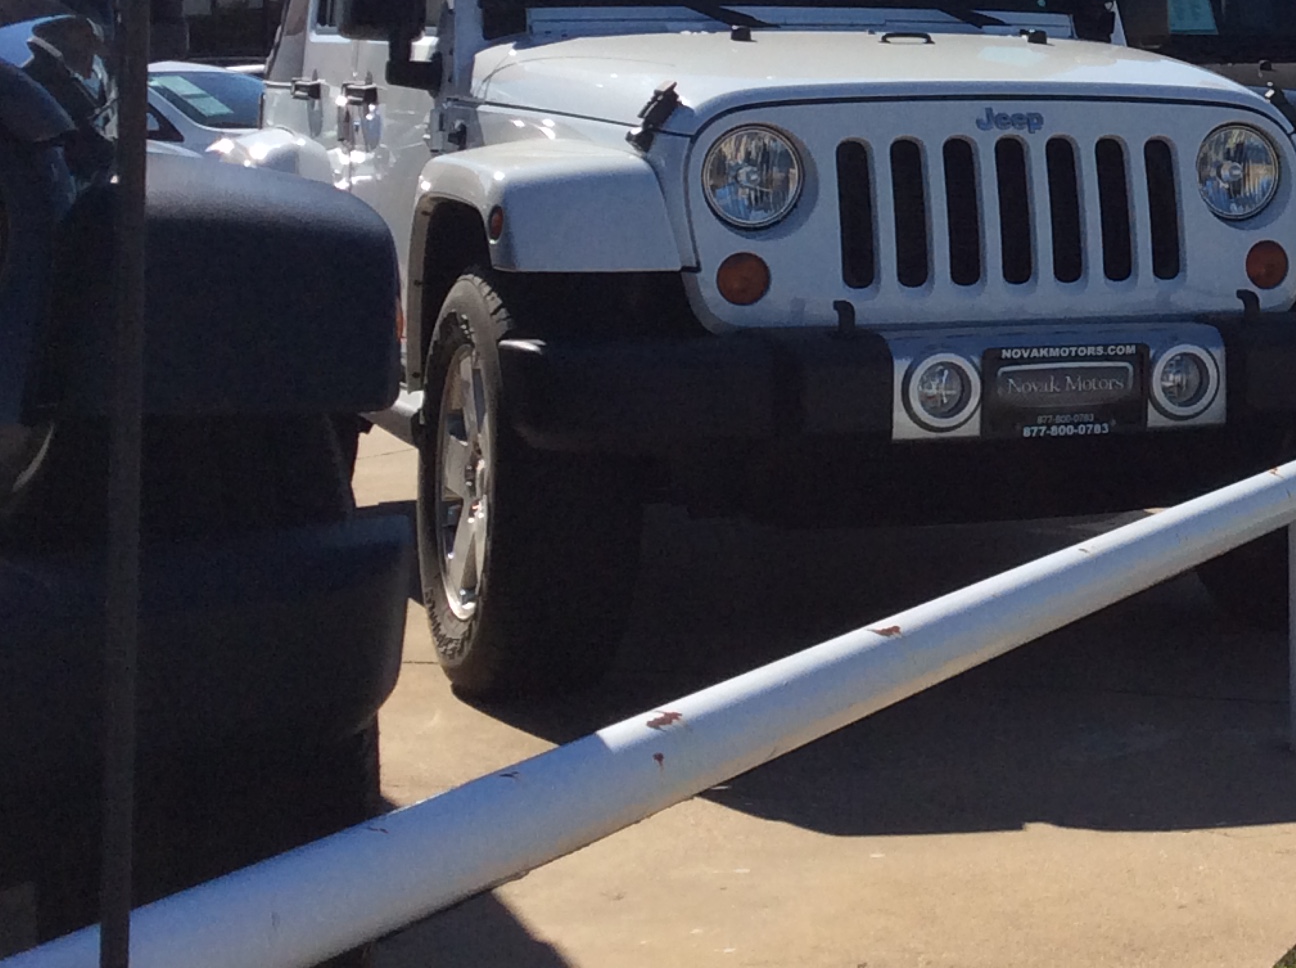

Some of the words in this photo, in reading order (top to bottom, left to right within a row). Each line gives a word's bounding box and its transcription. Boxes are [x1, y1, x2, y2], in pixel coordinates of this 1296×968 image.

[976, 107, 1044, 134] Jeep
[1001, 344, 1137, 359] NOVAKMOTORS.COM
[1008, 374, 1061, 395] Novak
[1065, 373, 1125, 393] Motors
